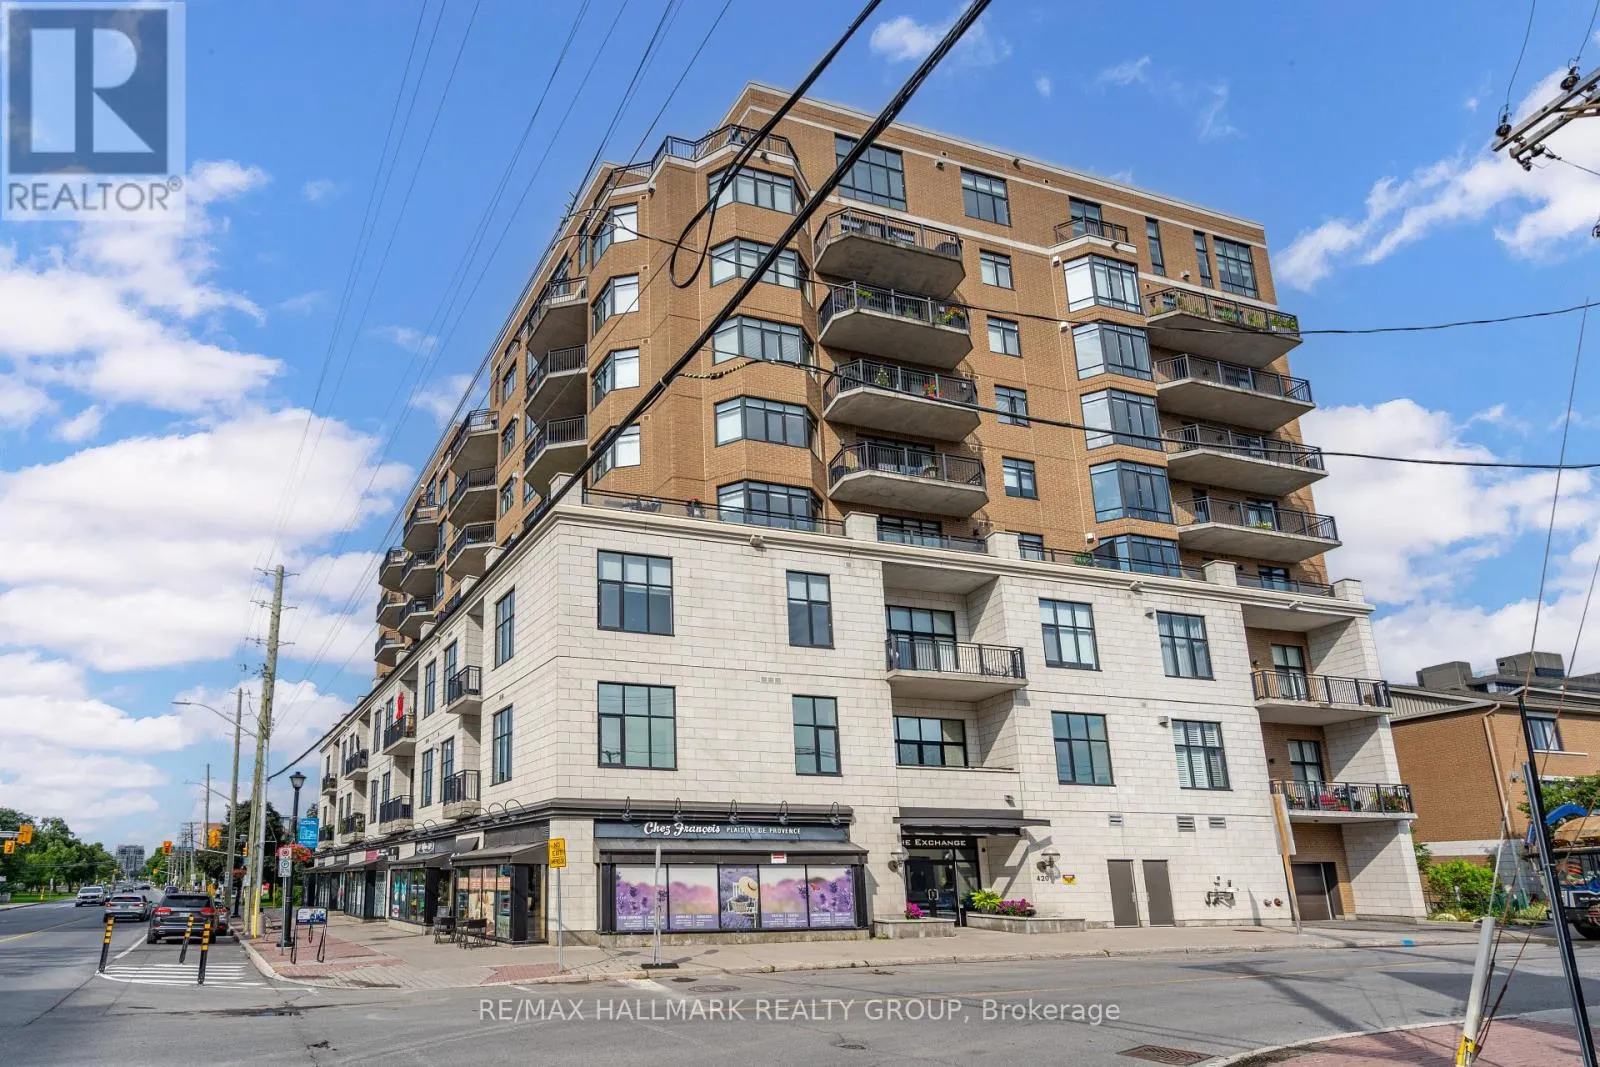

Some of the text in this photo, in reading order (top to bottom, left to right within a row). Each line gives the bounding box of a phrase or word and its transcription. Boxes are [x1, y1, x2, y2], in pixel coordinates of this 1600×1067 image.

[643, 821, 721, 836] Chez François
[726, 825, 801, 835] PLAISIRS DE PROVENCE
